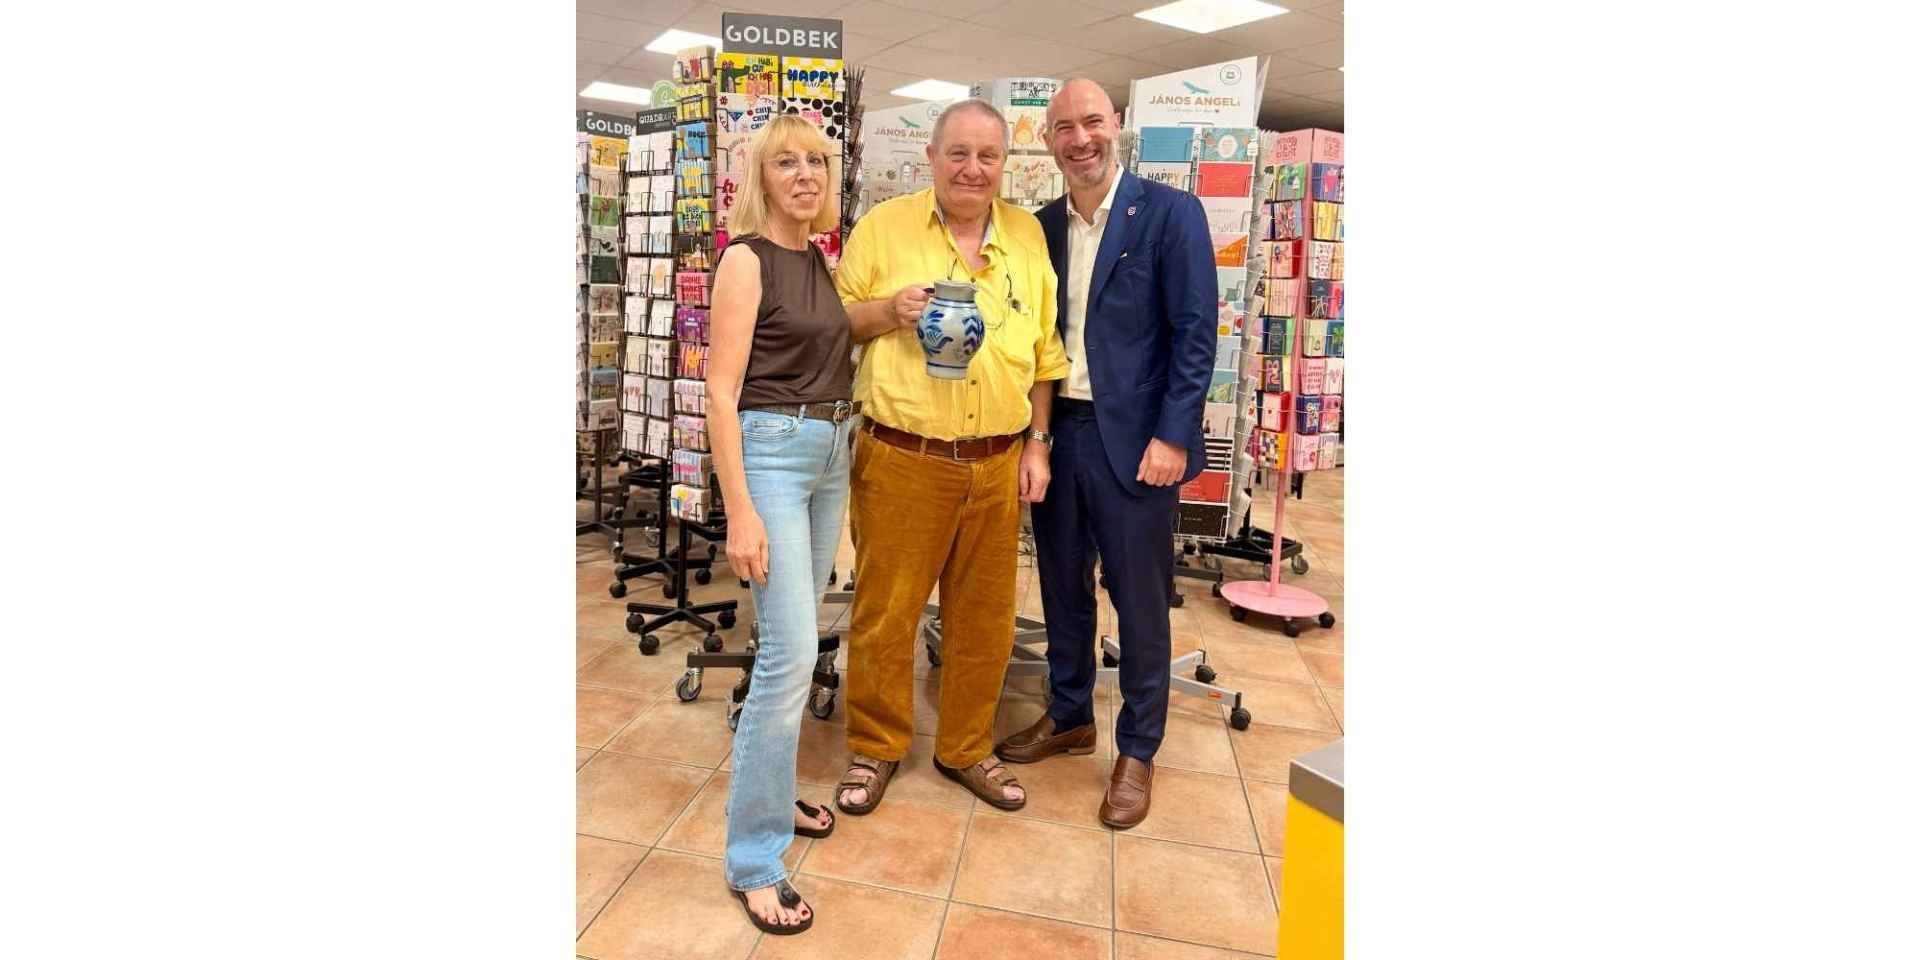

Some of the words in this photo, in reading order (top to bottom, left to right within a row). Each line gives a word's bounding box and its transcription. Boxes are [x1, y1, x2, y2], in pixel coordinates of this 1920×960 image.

[725, 24, 839, 49] GOLDBEK
[787, 68, 839, 83] HAPPY
[908, 129, 930, 140] ANG
[1146, 170, 1180, 183] HAPPY
